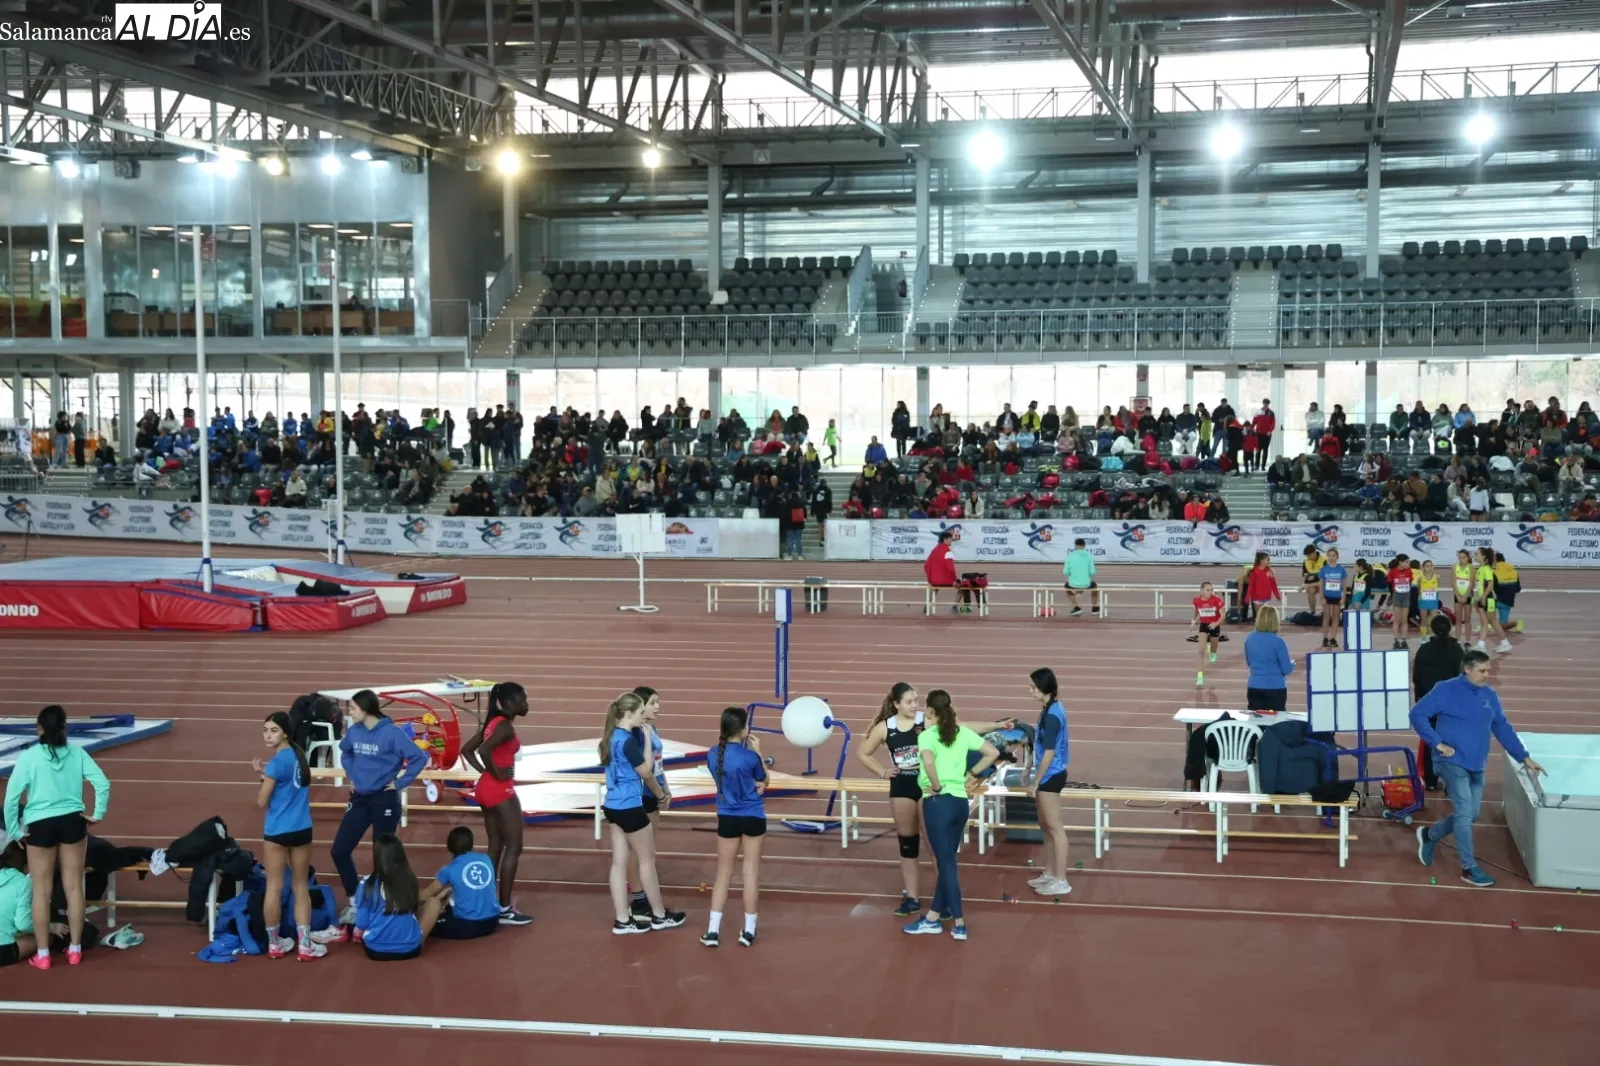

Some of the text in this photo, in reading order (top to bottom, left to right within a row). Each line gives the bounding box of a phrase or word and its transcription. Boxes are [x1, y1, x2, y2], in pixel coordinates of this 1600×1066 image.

[1360, 526, 1391, 535] FEDERACIÓN
[1462, 526, 1494, 535] FEDERACIÓN
[1383, 549, 1397, 558] LEÓN
[1592, 551, 1600, 559] LEÓ
[0, 604, 39, 616] ONDO
